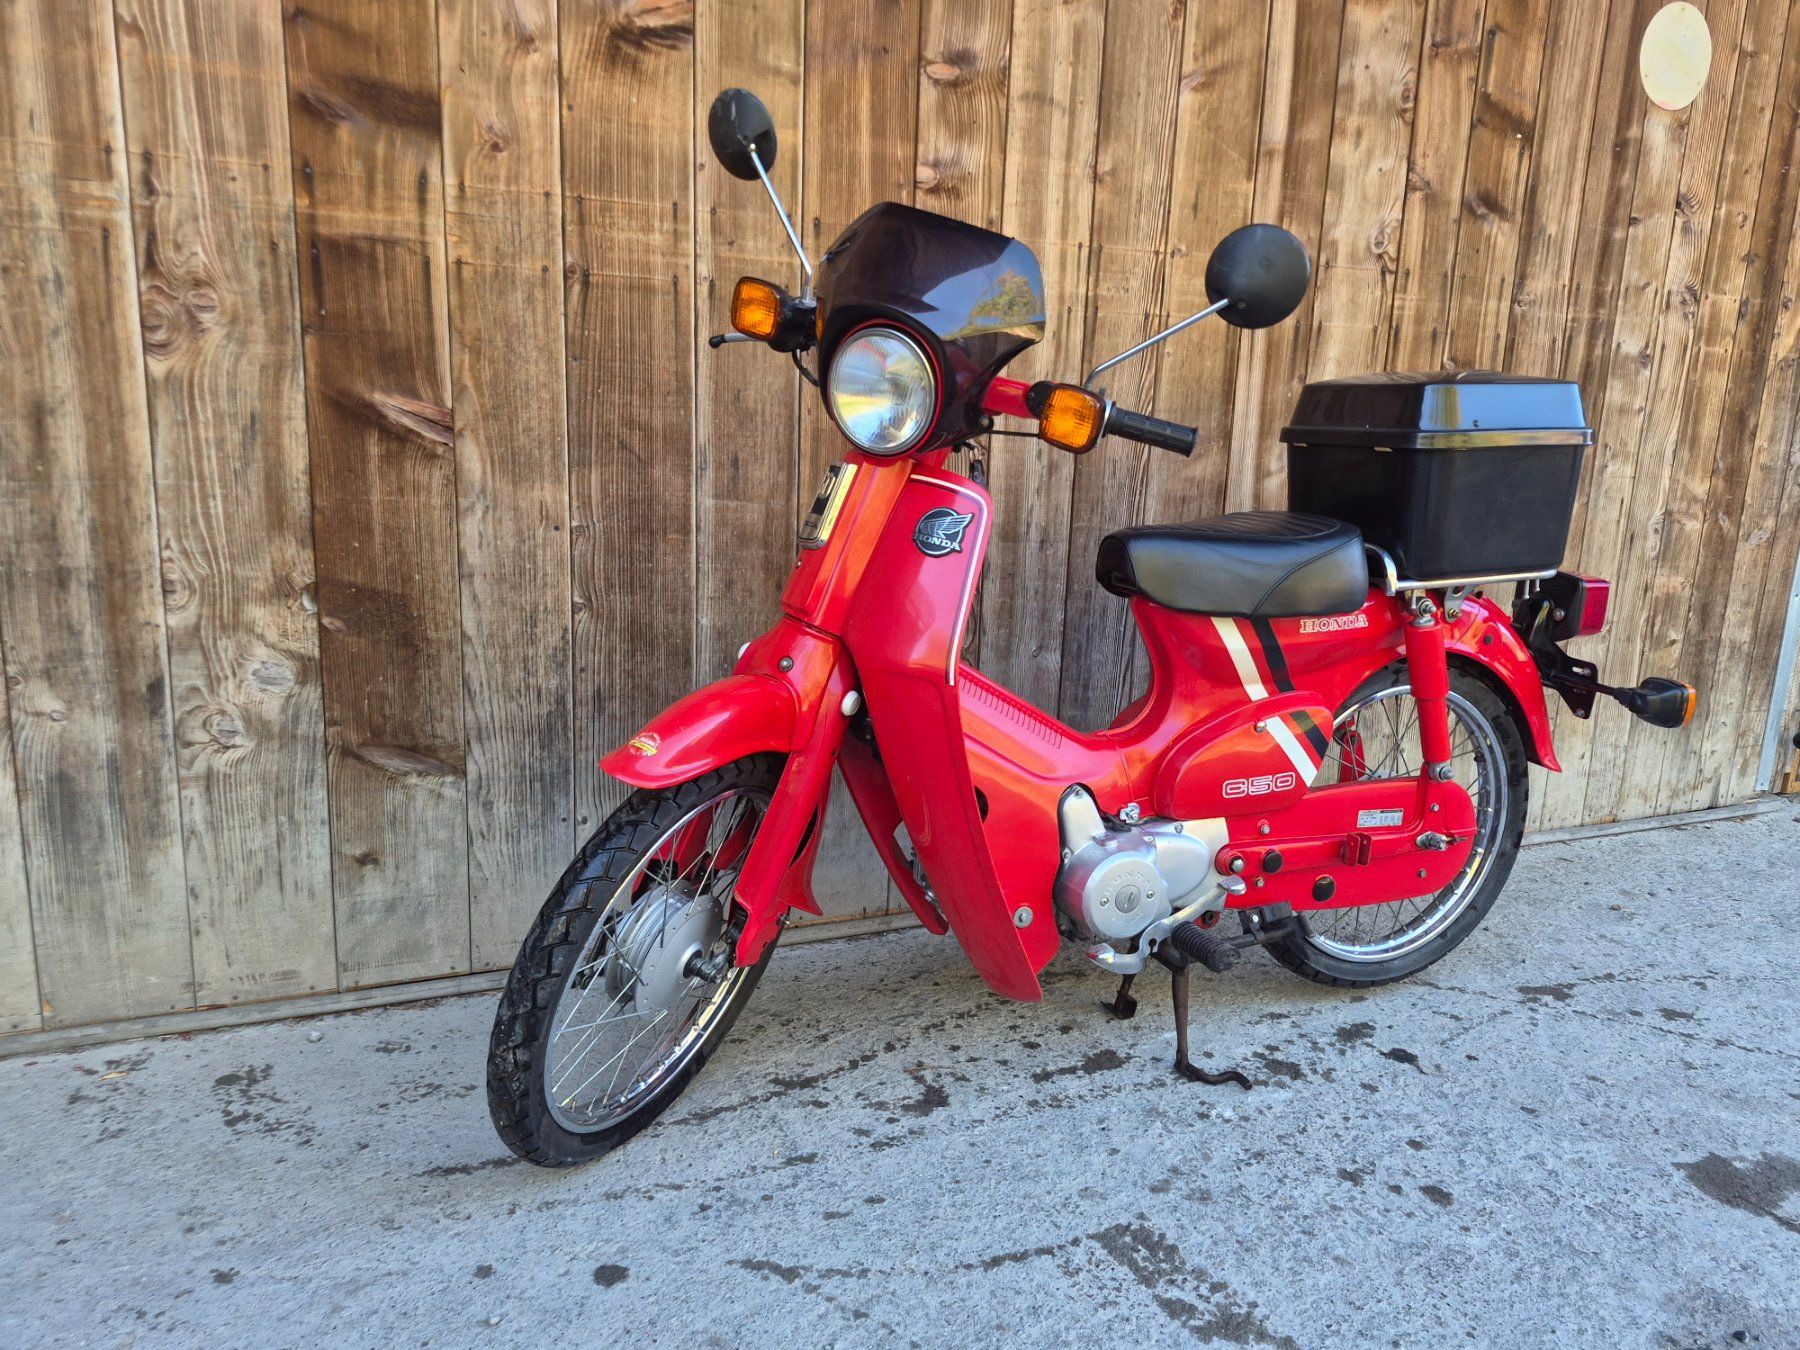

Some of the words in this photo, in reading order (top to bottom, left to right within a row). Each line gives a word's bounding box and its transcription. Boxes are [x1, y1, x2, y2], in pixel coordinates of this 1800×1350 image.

[913, 532, 962, 551] HONDA
[1300, 615, 1368, 633] HONDA
[1222, 771, 1295, 798] C50
[1103, 871, 1152, 897] HONDA
